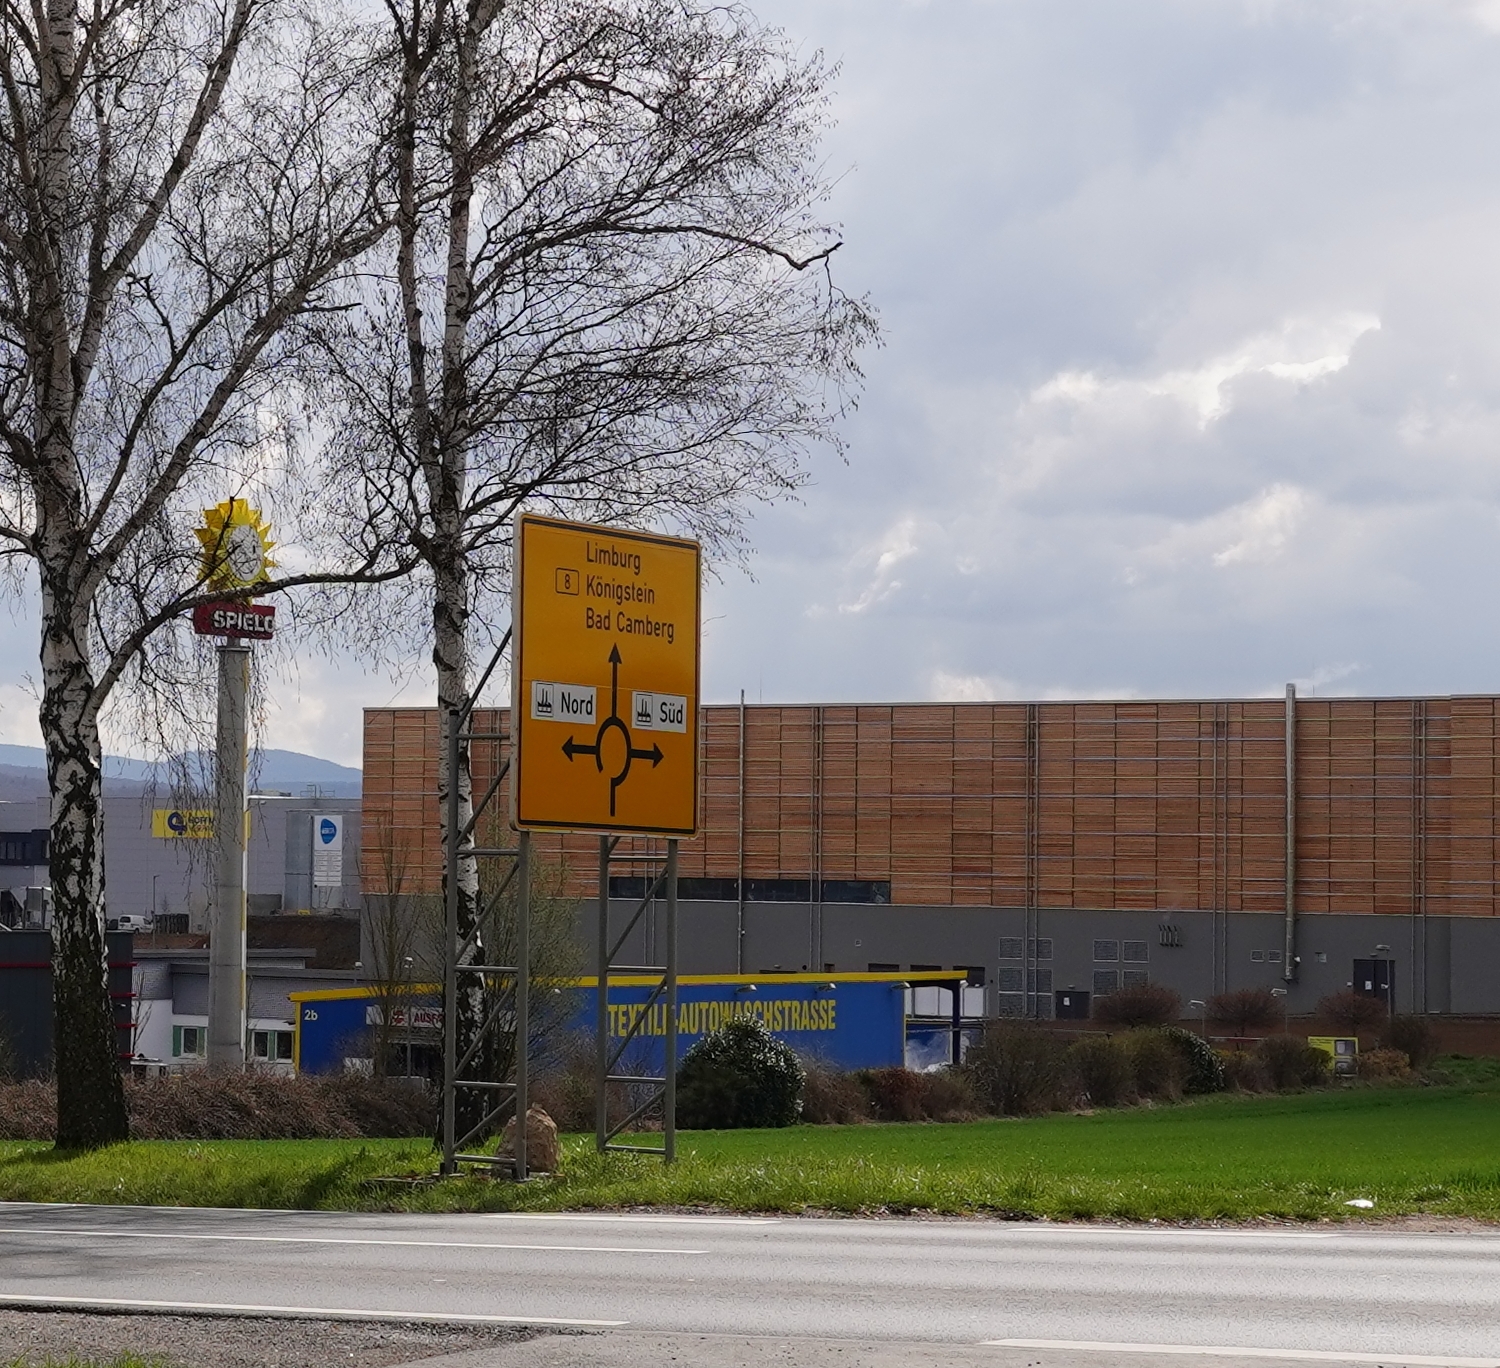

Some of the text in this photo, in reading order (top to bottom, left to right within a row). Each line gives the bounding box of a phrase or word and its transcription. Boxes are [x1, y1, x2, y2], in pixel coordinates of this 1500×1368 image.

[586, 541, 640, 575] Limburg
[564, 573, 655, 605] 8 Königstein
[586, 607, 674, 644] Bad Camberg
[561, 691, 593, 716] Nord
[659, 701, 683, 725] Süd
[304, 1009, 318, 1021] 2b
